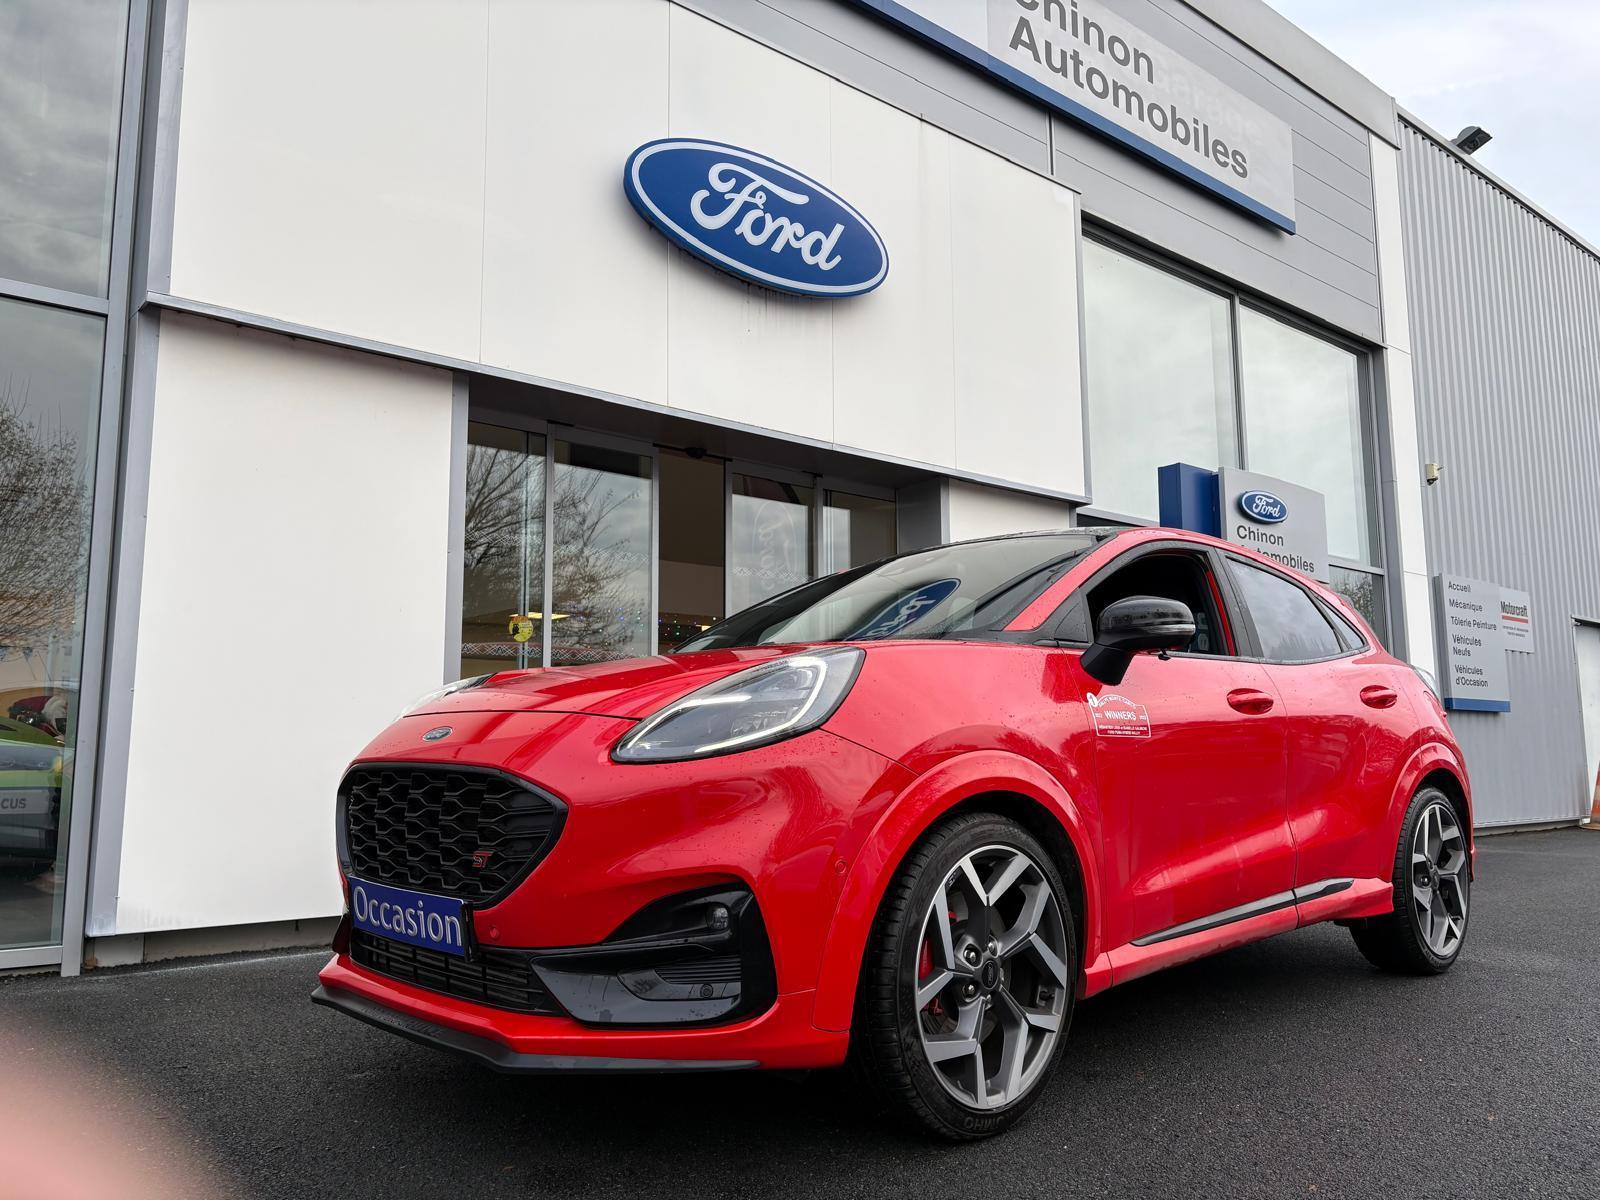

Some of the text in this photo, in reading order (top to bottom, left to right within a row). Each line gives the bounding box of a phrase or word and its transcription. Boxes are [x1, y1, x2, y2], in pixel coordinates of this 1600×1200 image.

[1016, 0, 1154, 84] hinon
[1009, 15, 1248, 179] Automobiles
[690, 162, 845, 271] Ford
[1252, 495, 1281, 517] Ford
[1236, 525, 1284, 546] Chinon
[1448, 581, 1472, 592] Accueil
[1449, 598, 1483, 613] Mécanique
[1500, 600, 1528, 617] Motorcraft
[1473, 619, 1497, 631] Peinture
[1452, 633, 1482, 647] Véhicules
[1453, 646, 1472, 657] Neufs
[1455, 664, 1483, 676] Véhicules
[1456, 676, 1489, 688] d'Occasion
[1104, 710, 1137, 721] WINNERS
[353, 885, 462, 947] Occasion
